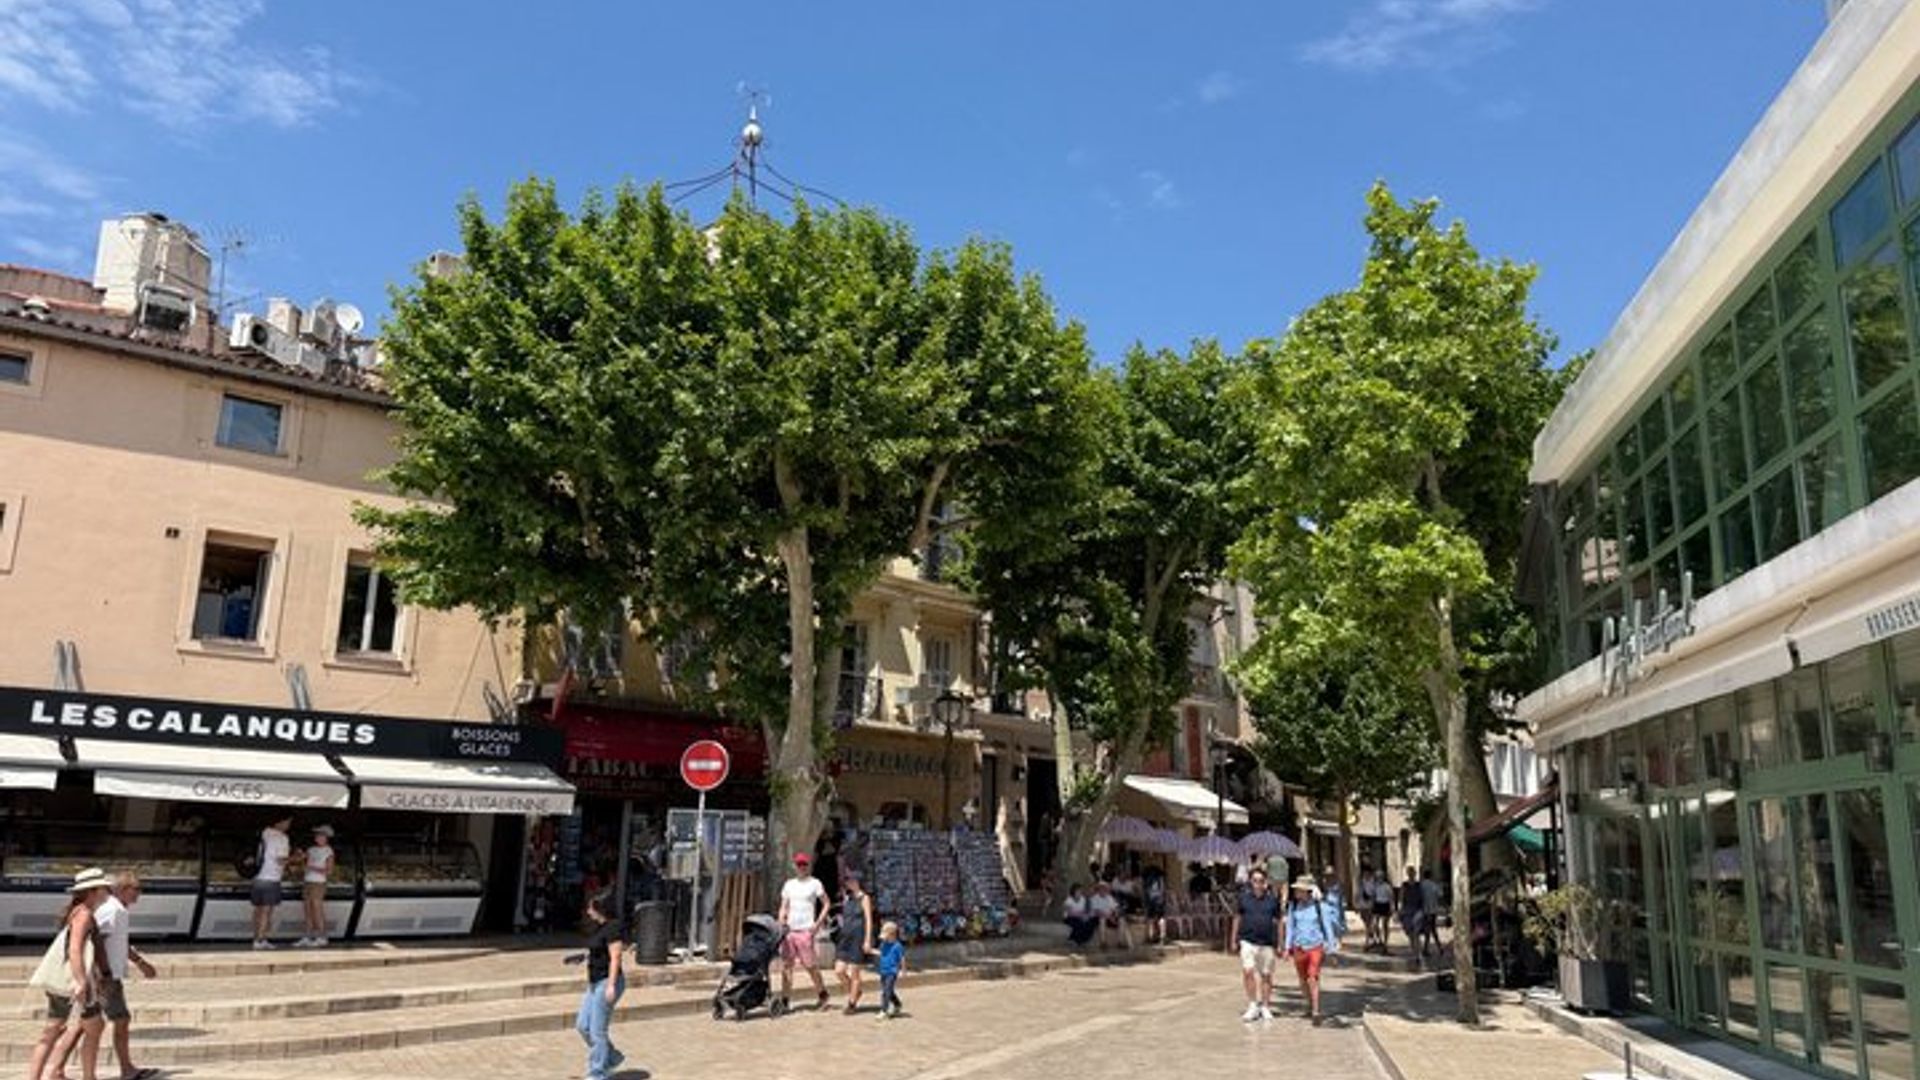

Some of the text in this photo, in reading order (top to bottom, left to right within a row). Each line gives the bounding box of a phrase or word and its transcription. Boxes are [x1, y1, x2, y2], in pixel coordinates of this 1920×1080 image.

[30, 700, 376, 744] LES CALANQUES
[452, 727, 521, 744] BOISSONS
[458, 743, 512, 756] GLACES
[567, 755, 654, 778] TABAC
[192, 780, 264, 799] GLACES
[387, 792, 448, 809] GLACES
